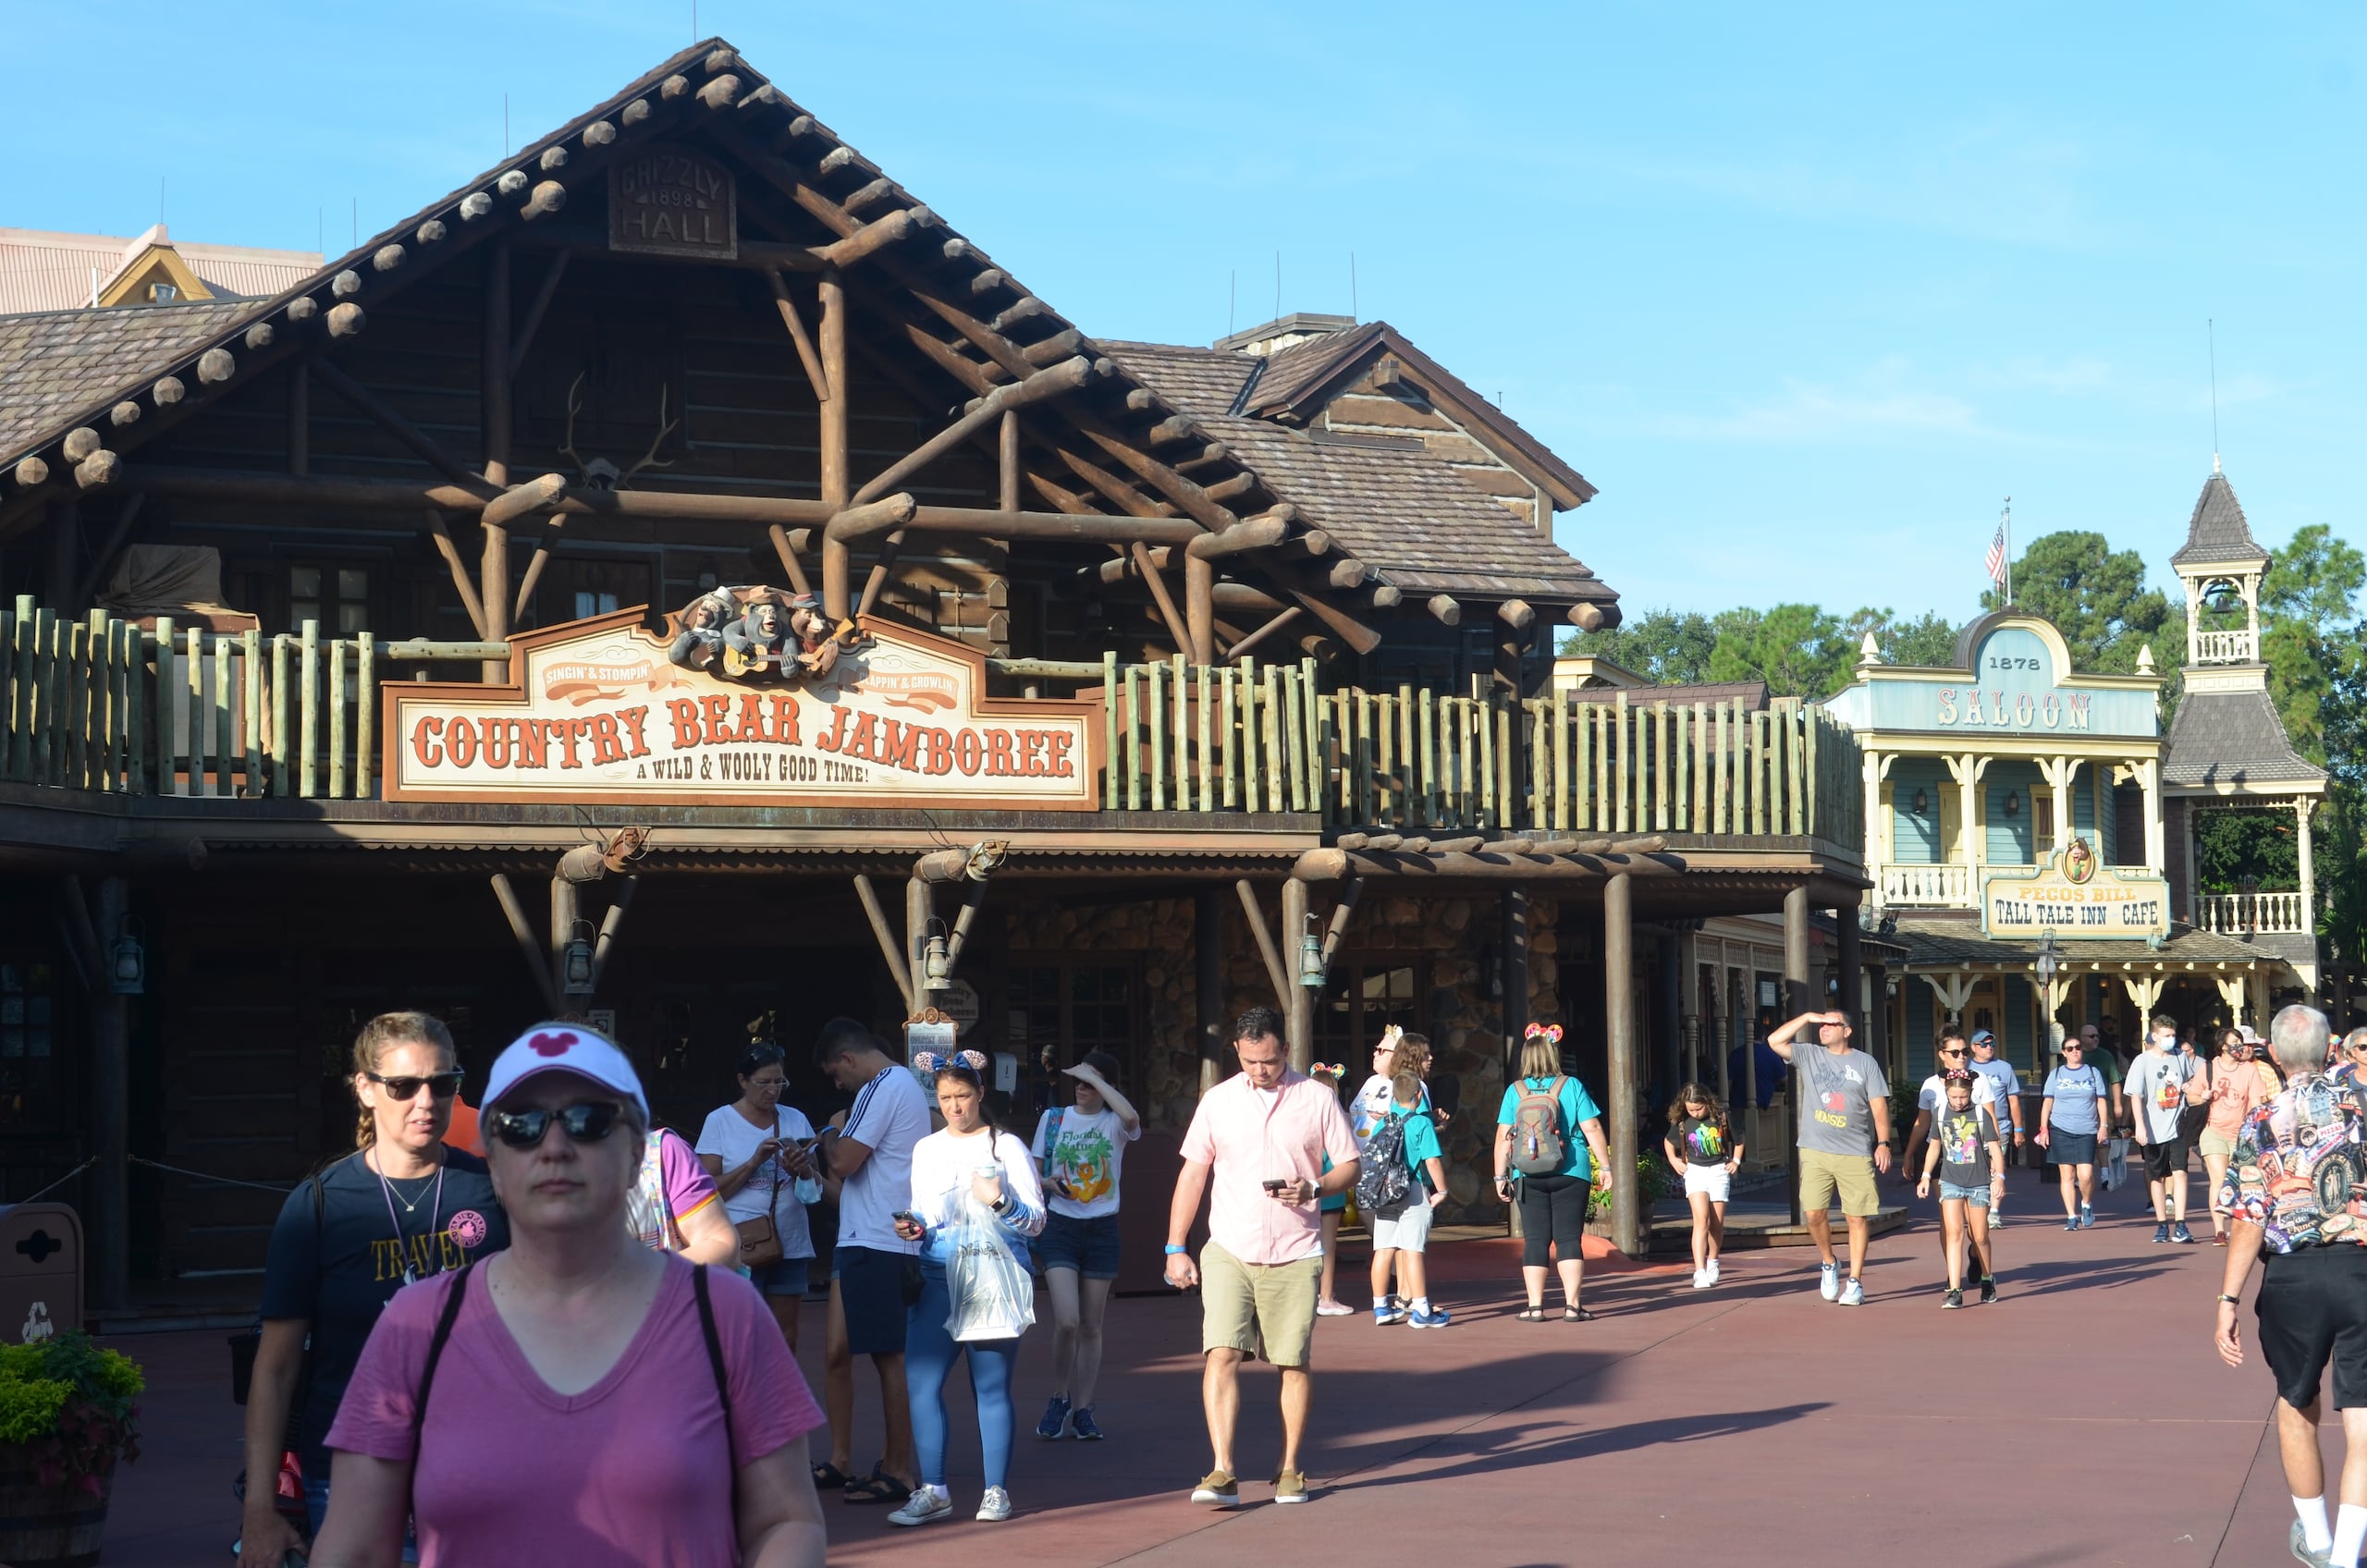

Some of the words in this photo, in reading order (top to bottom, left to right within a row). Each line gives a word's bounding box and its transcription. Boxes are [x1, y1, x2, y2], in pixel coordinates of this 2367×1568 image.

[621, 154, 721, 201] GRIZZLY
[651, 189, 693, 208] 1898
[621, 208, 723, 245] HALL
[546, 666, 587, 685] SINGIN'
[588, 667, 597, 680] &
[599, 663, 651, 681] STOMPIN'
[1990, 657, 2041, 671] 1878
[901, 678, 911, 689] &
[911, 676, 956, 692] GROWLIN'
[1937, 688, 2091, 730] SALOON
[410, 704, 651, 769] COUNTRY
[666, 693, 802, 750] BEAR
[816, 704, 1074, 778] JAMBOREE
[637, 764, 647, 779] A
[652, 755, 693, 779] WILD
[700, 753, 713, 780] &
[718, 753, 772, 781] WOOLY
[779, 753, 817, 782] GOOD
[824, 759, 869, 783] TIME!
[2018, 887, 2085, 902] PECOS
[2091, 888, 2137, 902] BILL
[1995, 899, 2032, 925] TALL
[2037, 903, 2074, 925] TALE
[2080, 906, 2107, 925] INN
[2122, 900, 2158, 925] CAFE
